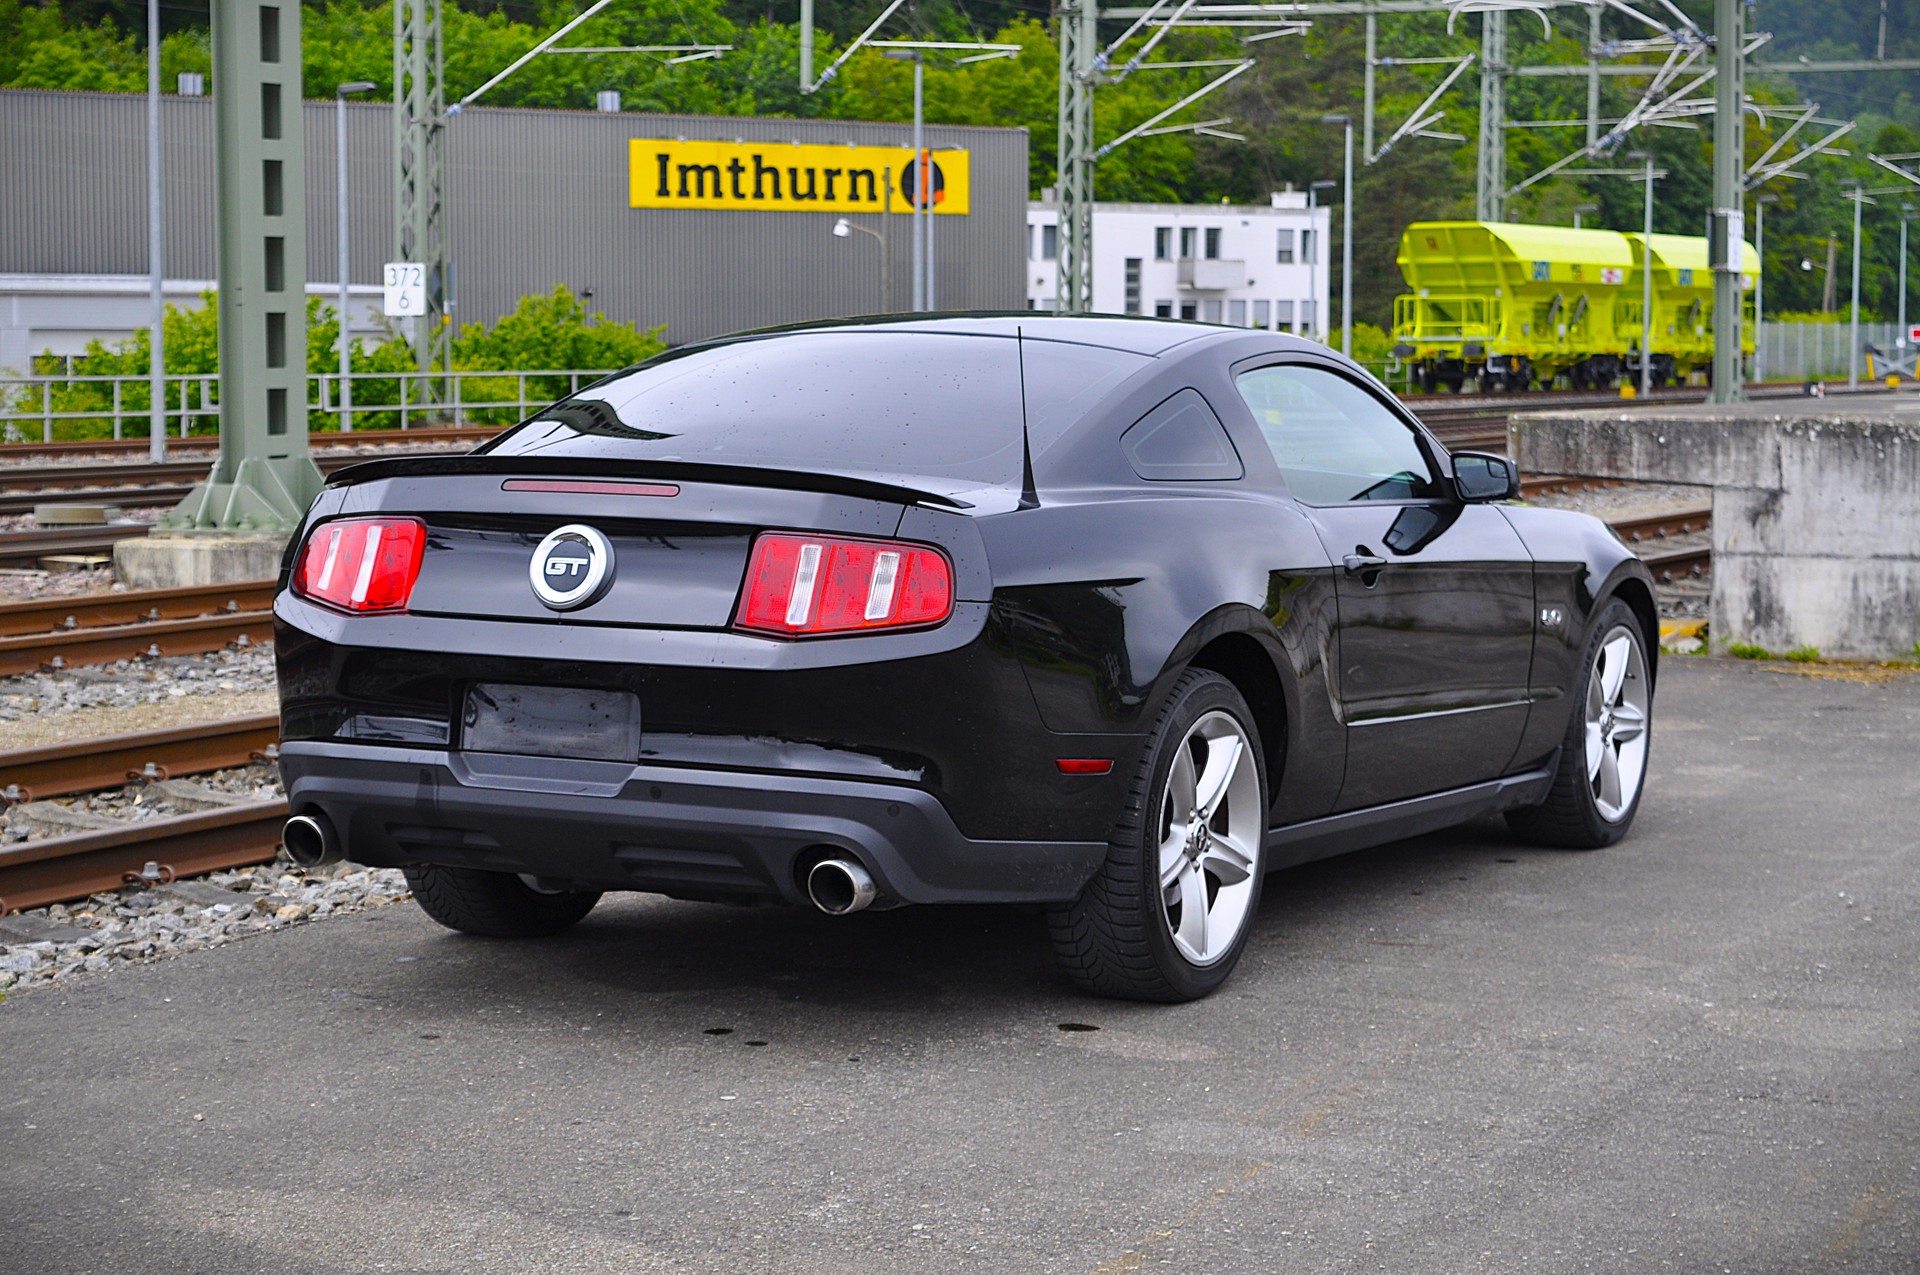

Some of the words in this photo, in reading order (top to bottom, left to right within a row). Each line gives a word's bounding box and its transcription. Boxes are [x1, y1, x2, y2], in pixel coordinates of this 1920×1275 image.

[656, 154, 878, 201] Imthurn
[387, 267, 421, 287] 372
[399, 289, 409, 310] 6
[545, 557, 589, 576] GT
